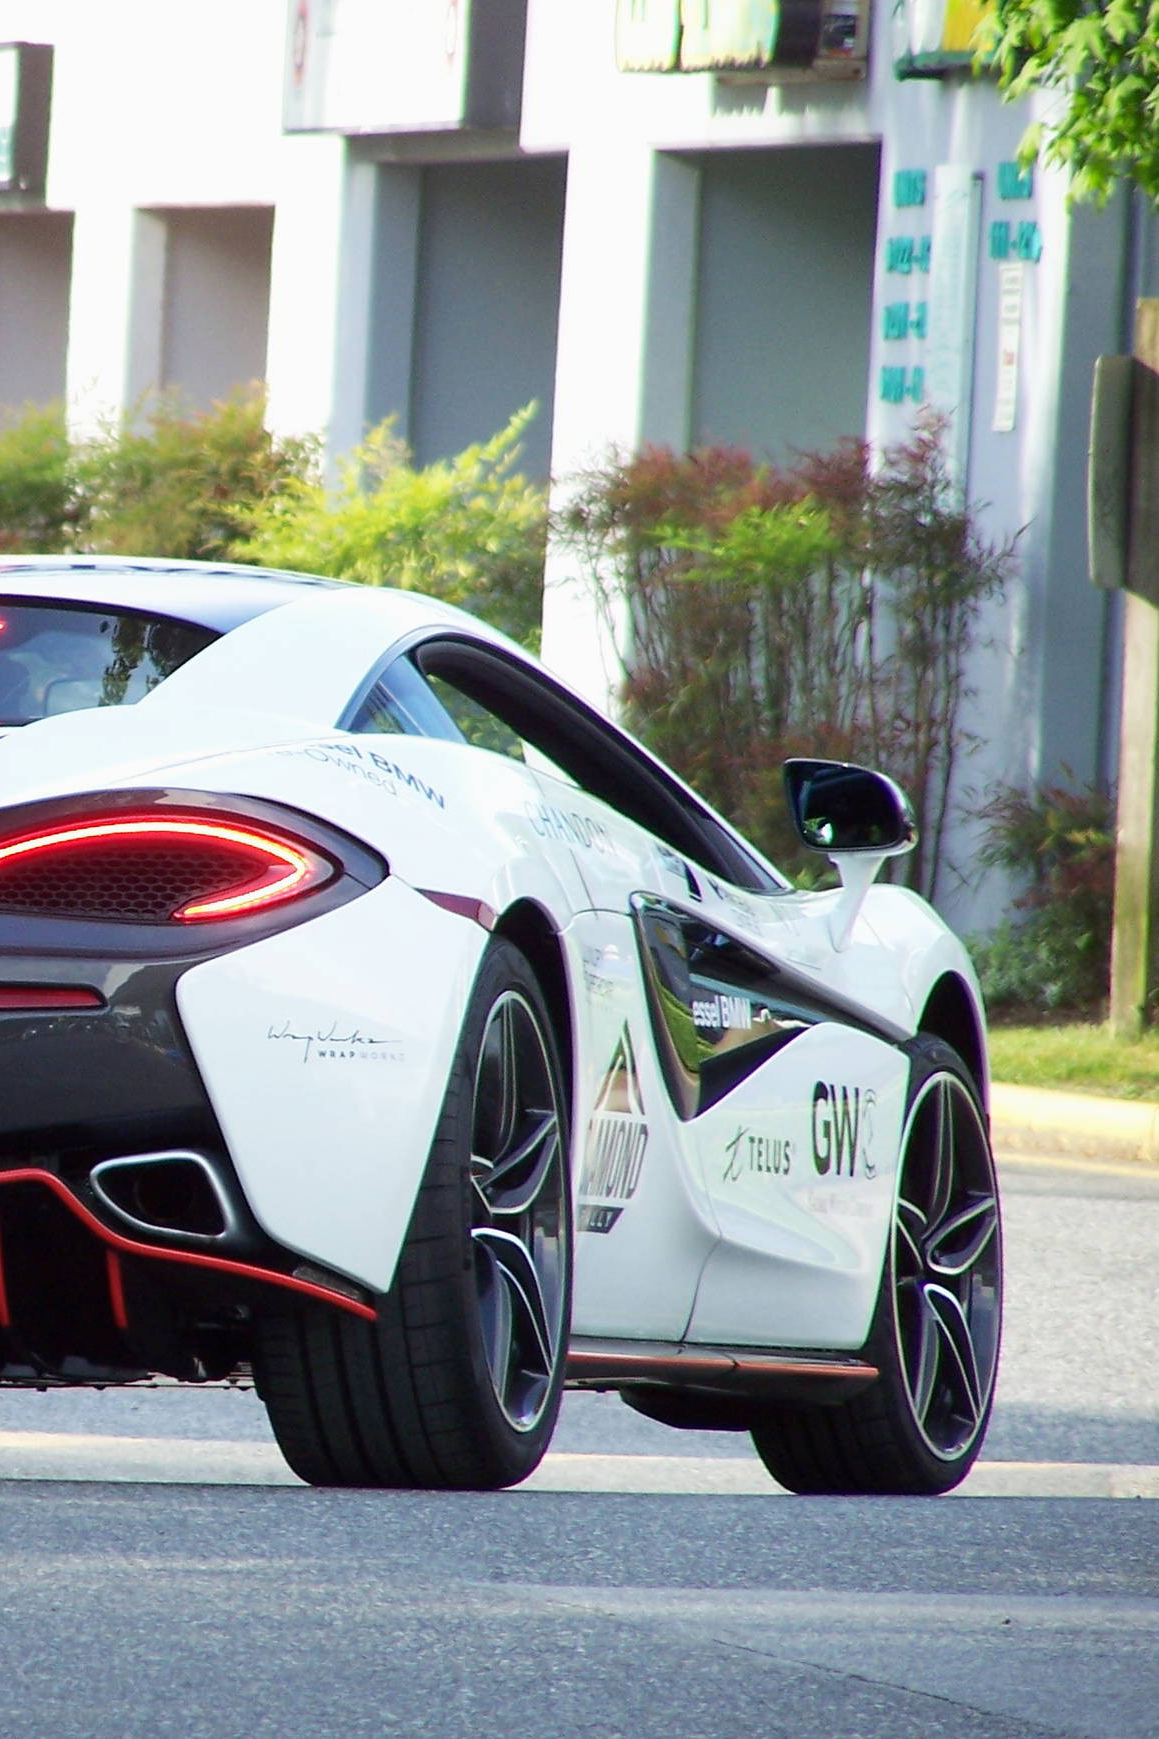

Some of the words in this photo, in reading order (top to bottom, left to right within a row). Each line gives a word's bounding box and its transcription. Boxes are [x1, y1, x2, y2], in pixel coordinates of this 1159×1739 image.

[368, 751, 445, 809] BMW
[720, 995, 751, 1029] BMW
[748, 1135, 791, 1176] TELUS
